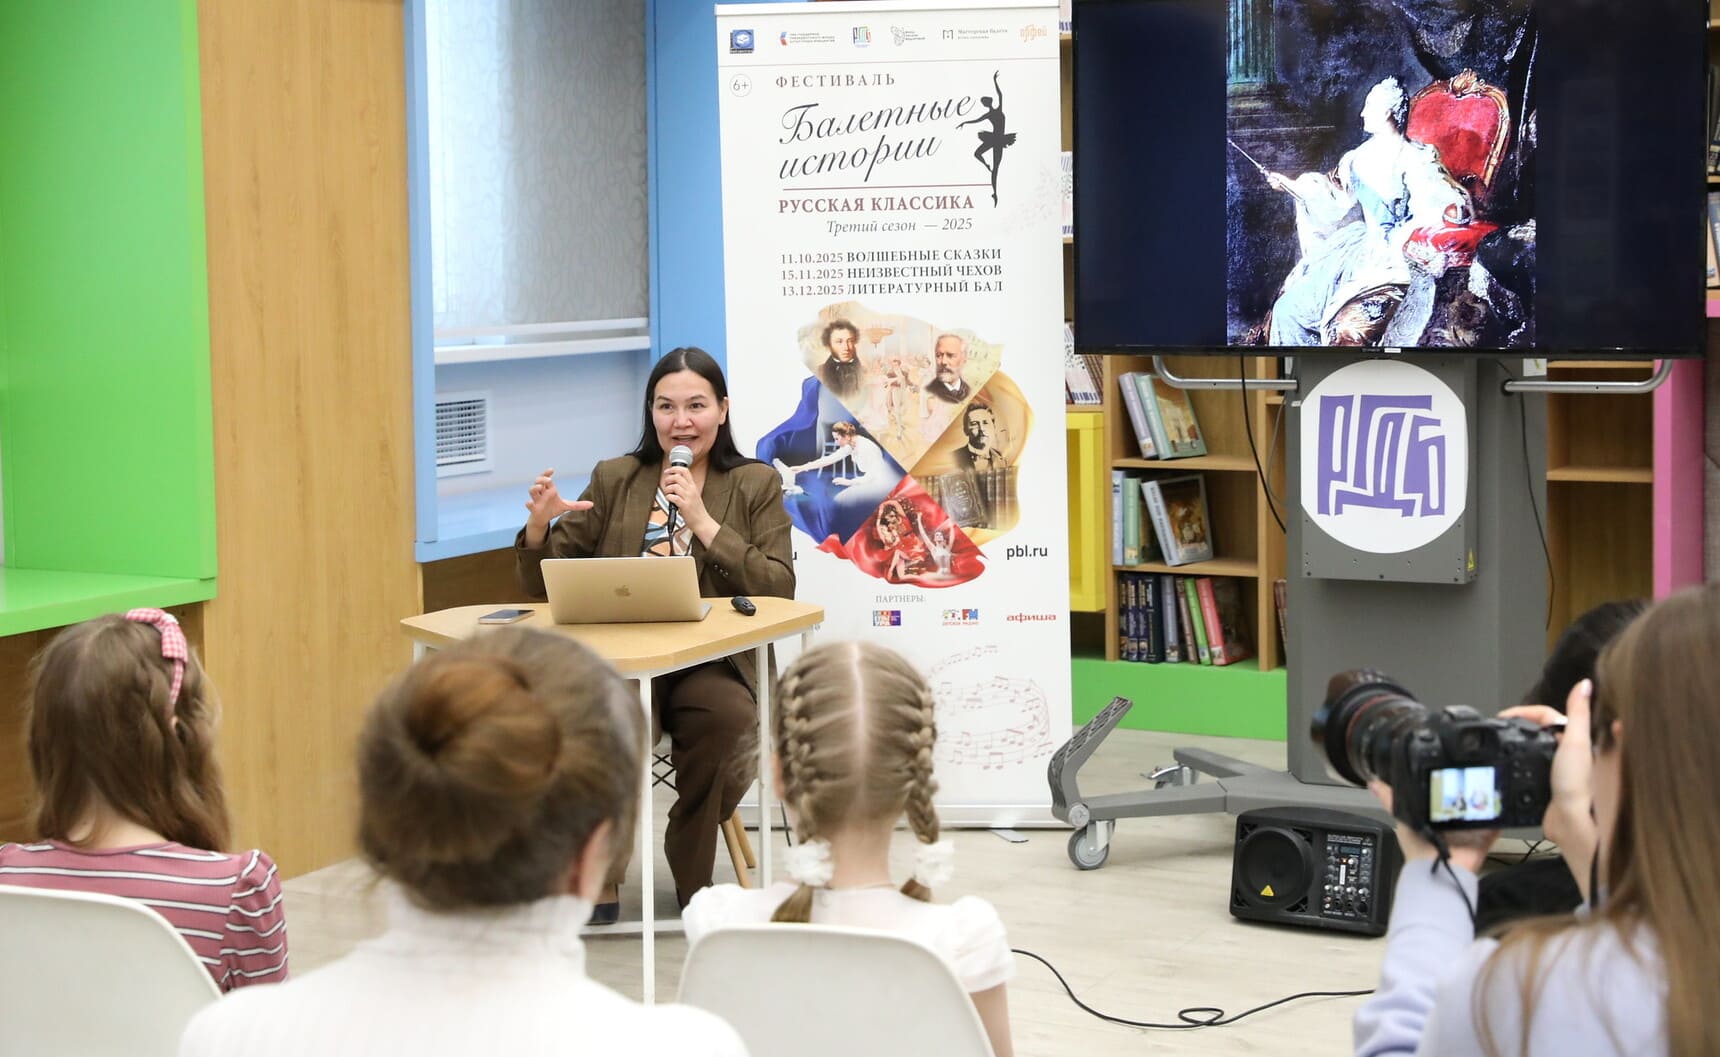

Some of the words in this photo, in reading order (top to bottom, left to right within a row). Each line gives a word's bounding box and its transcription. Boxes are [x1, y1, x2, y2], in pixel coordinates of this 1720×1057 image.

[732, 80, 749, 91] 6+
[776, 73, 895, 88] ФЕСТИВАЛЬ
[779, 95, 976, 145] Балетные
[779, 135, 942, 183] истории
[778, 198, 865, 214] РУССКАЯ
[871, 195, 975, 211] КЛАССИКА
[827, 219, 879, 237] Третий
[881, 222, 917, 232] сезон
[941, 217, 973, 231] 2025
[781, 252, 844, 264] 11.10.2025
[846, 249, 941, 263] ВОЛШЕБНЫЕ
[943, 248, 1002, 261] СКАЗКИ
[781, 268, 844, 280] 15.11.2025
[847, 264, 953, 279] НЕИЗВЕСТНЫЙ
[956, 264, 1003, 276] ЧЕХОВ
[781, 284, 845, 296] 13.12.2025
[847, 280, 969, 295] ЛИТЕРАТУРНЫЙ
[973, 280, 1004, 293] БАЛ
[1006, 545, 1048, 560] pbl.ru
[1006, 612, 1057, 623] афиша
